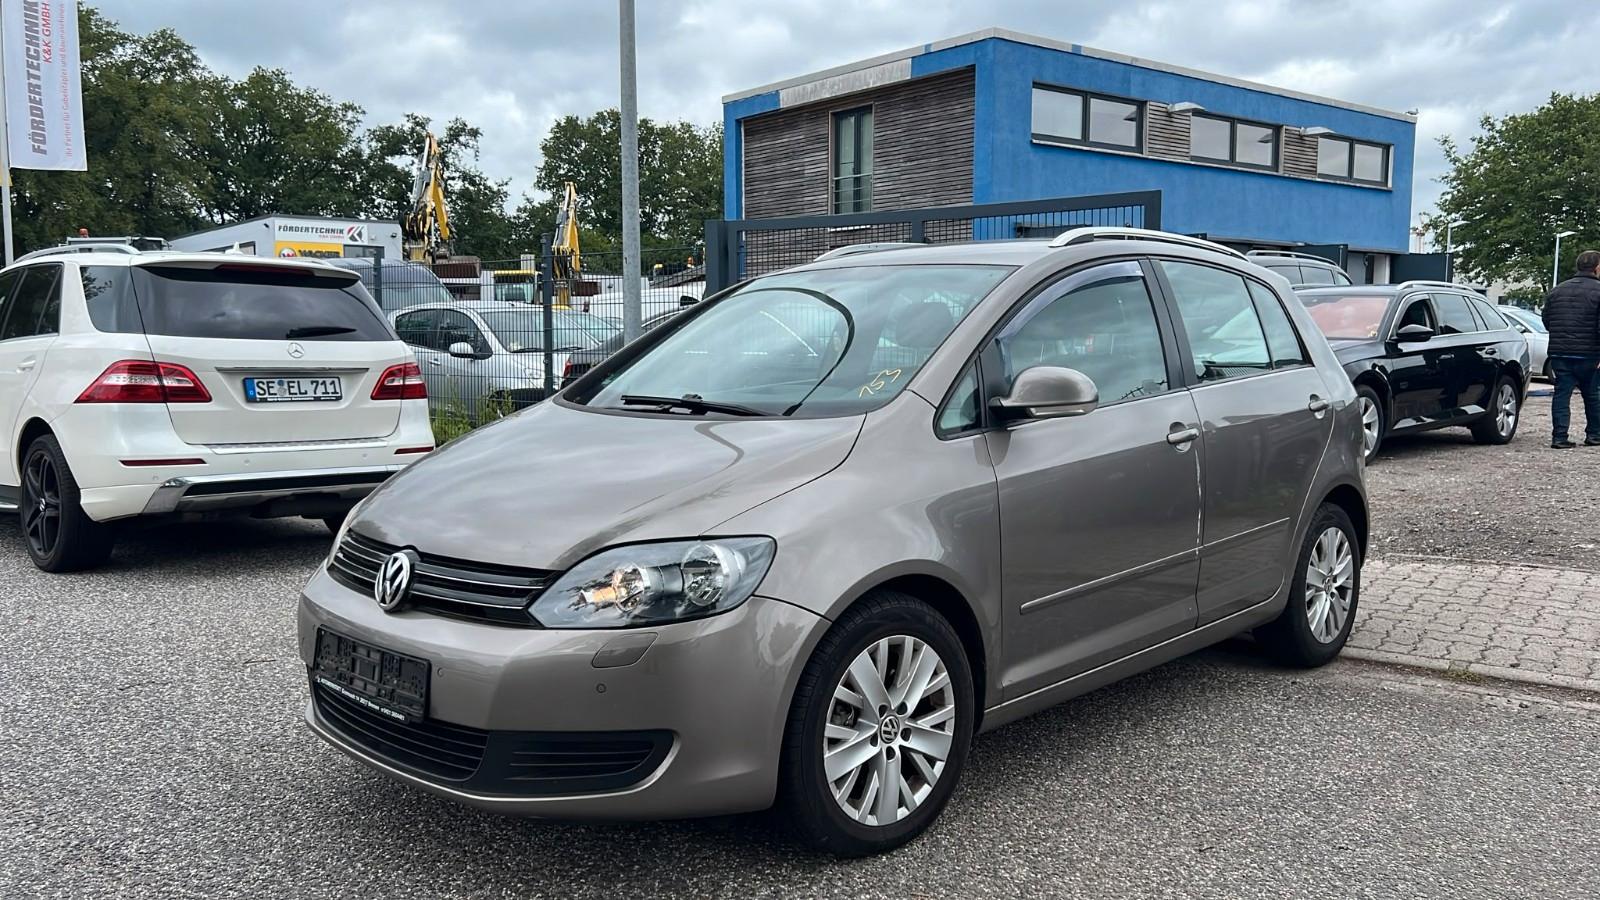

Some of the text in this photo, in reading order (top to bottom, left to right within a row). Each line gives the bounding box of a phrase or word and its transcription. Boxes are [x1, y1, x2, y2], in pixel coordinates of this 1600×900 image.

[41, 2, 53, 64] K&K GMBH
[24, 0, 48, 156] FÖRDERTECHNIK
[278, 224, 345, 235] FÖRDERTECHNIK
[256, 380, 340, 397] SE EL 711
